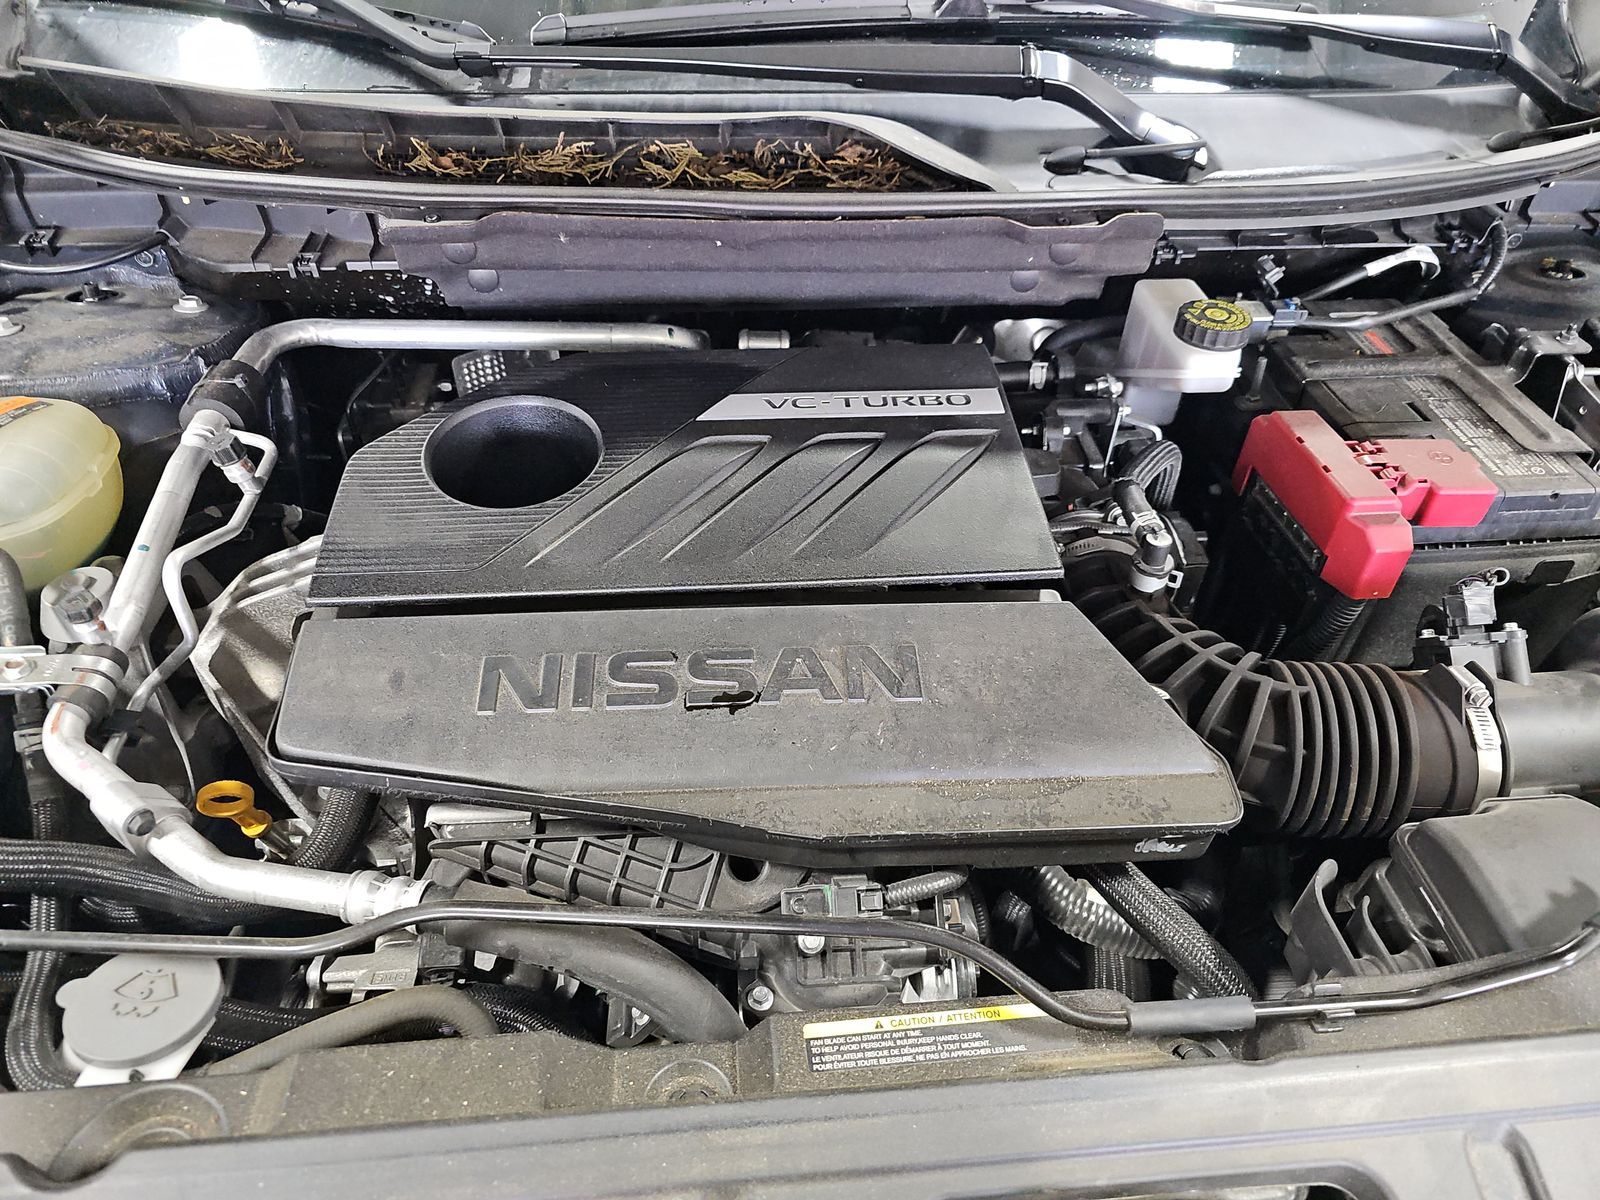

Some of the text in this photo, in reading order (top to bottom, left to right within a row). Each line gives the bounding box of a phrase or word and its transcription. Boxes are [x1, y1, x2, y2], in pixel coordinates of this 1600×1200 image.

[761, 394, 972, 409] VC-TURBO
[475, 644, 924, 716] NISSAN
[890, 1016, 935, 1028] CAUTION
[947, 1010, 1001, 1022] ATTENTION
[822, 1045, 839, 1053] HELP
[840, 1043, 860, 1051] AVOID
[860, 1040, 896, 1050] PERSONAL
[936, 1034, 960, 1042] HANDS
[960, 1032, 984, 1040] CLEAR.
[824, 1037, 846, 1045] BLADE
[862, 1033, 883, 1042] START
[812, 1063, 833, 1071] POUR
[834, 1060, 857, 1070] ÉVITER
[856, 1059, 879, 1067] TOUTE
[950, 1048, 992, 1058] APPROCHER
[1005, 1044, 1028, 1053] MAINS.
[822, 1052, 864, 1062] VENTILATEUR
[864, 1050, 890, 1058] RISQUE
[900, 1046, 937, 1054] DÉMARRER
[938, 1042, 943, 1050] À
[943, 1042, 960, 1050] TOUT
